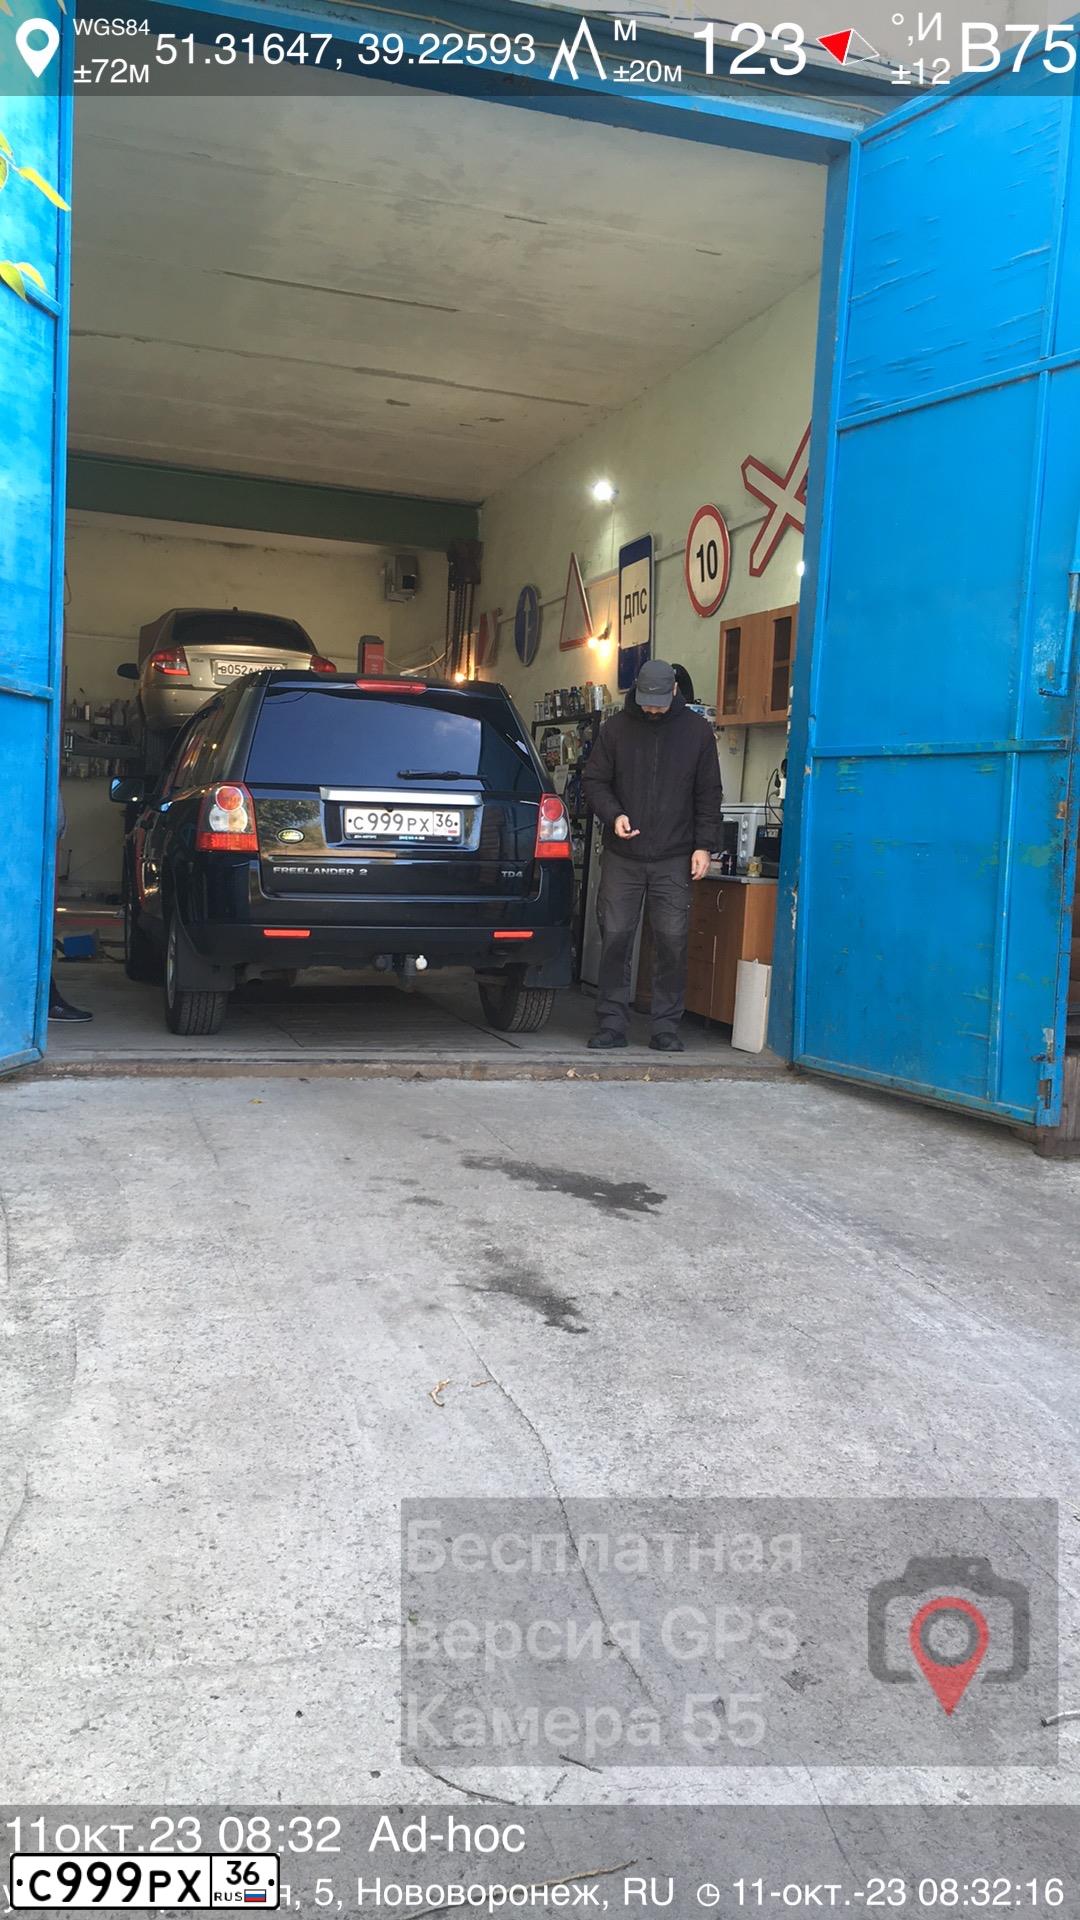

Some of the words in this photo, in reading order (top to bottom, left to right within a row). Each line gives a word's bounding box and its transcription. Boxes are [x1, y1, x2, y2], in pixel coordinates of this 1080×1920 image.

[696, 539, 718, 582] 10
[623, 587, 648, 625] ДПС
[353, 812, 430, 832] С999РХ
[435, 814, 454, 828] 36
[272, 866, 355, 876] FREELANDER
[359, 867, 369, 877] 2
[501, 870, 523, 878] TD4
